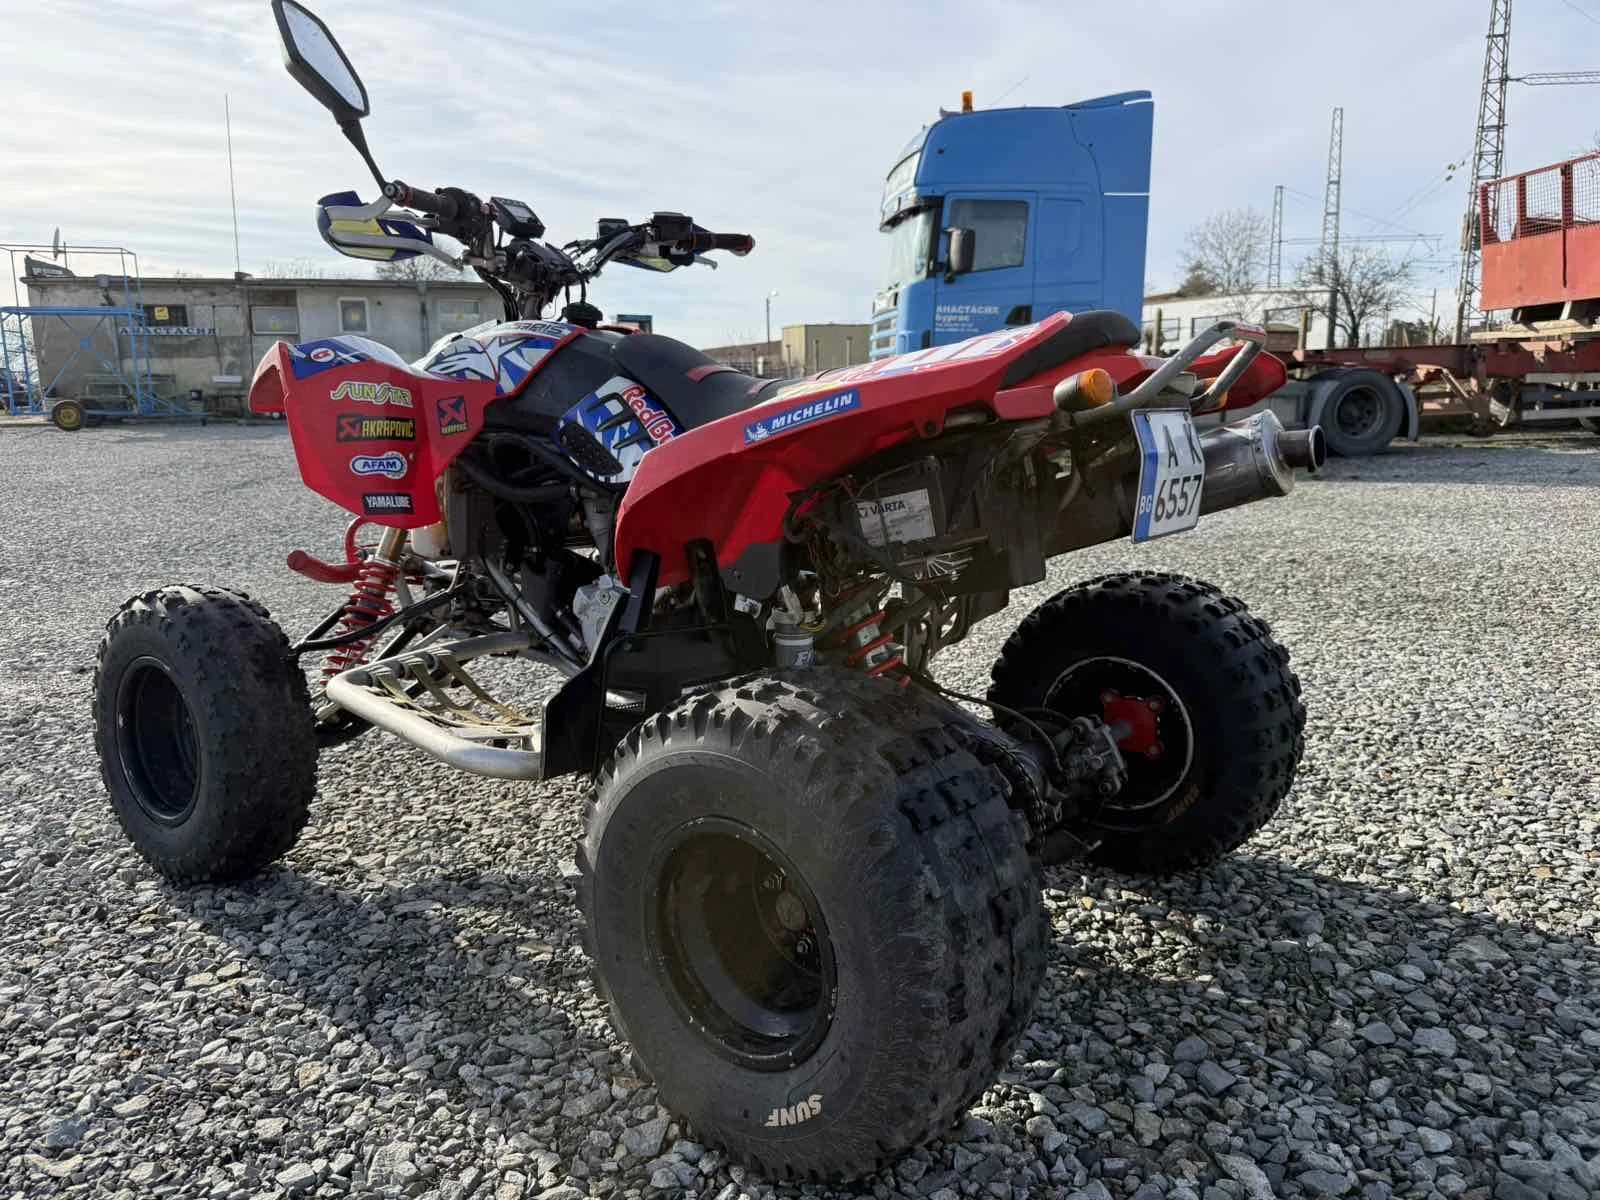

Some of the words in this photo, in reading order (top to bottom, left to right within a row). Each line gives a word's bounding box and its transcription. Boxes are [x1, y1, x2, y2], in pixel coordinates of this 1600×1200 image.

[771, 392, 853, 429] MICHELIN
[362, 460, 398, 470] AFAM
[366, 495, 411, 508] YAMALUBE
[870, 500, 907, 515] VARTA
[1139, 495, 1152, 515] BG
[1154, 474, 1203, 523] 6557
[764, 1094, 824, 1128] SUNF
